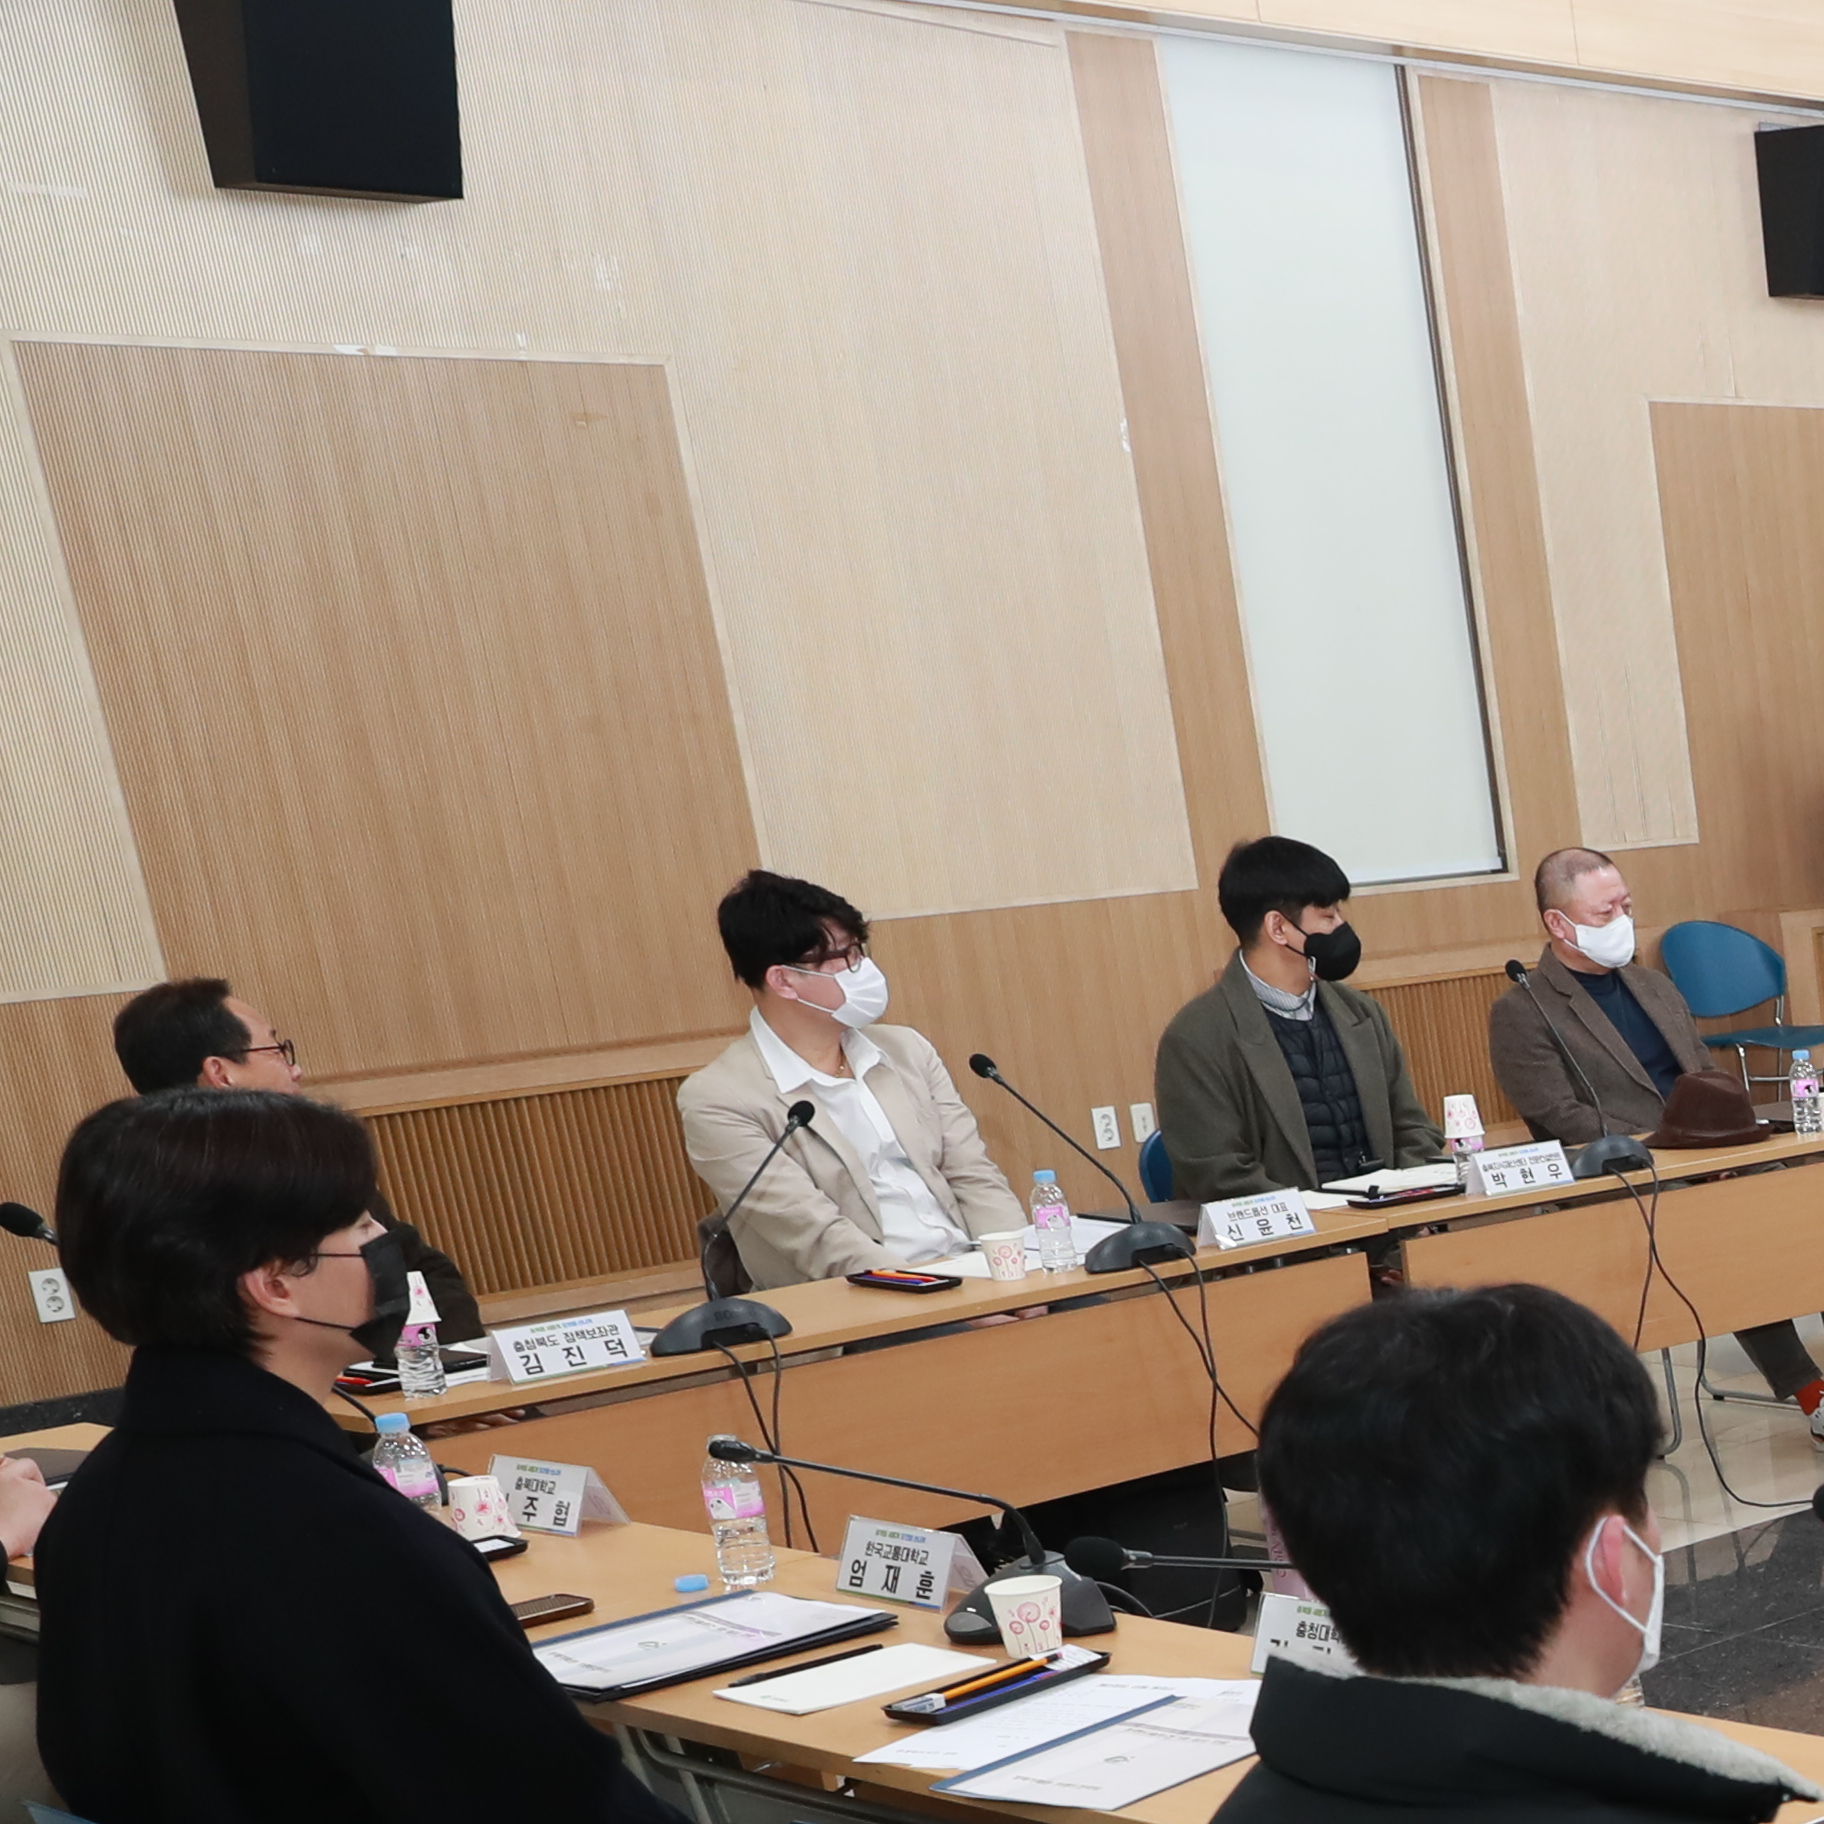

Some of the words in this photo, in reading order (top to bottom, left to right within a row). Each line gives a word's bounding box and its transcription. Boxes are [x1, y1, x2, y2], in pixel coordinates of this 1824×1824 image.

[513, 1335, 561, 1353] 충청북도
[563, 1324, 621, 1343] 정책보좌관
[514, 1476, 557, 1495] 충북대학교
[865, 1541, 930, 1566] 한국교통대학교
